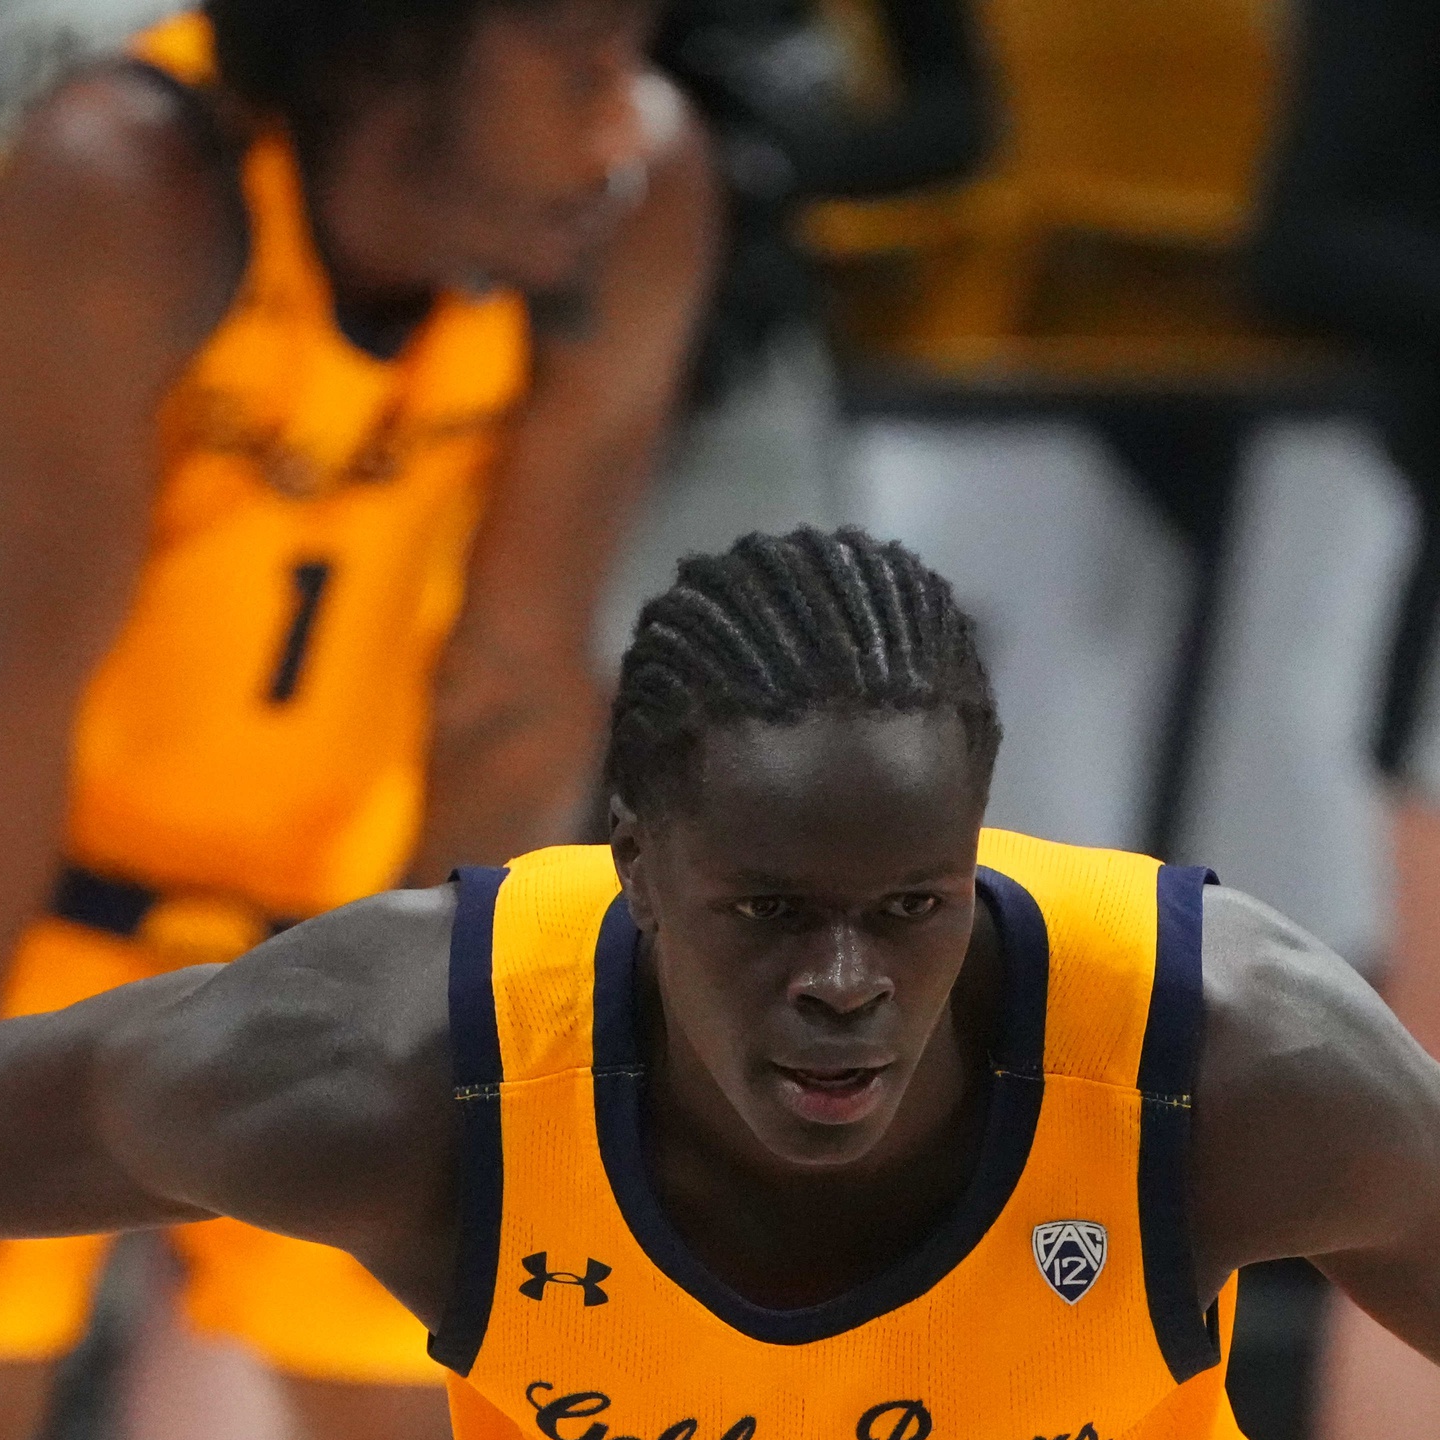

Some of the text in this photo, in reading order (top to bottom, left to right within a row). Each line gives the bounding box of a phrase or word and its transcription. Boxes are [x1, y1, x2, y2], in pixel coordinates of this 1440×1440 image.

[267, 562, 332, 706] 1
[1036, 1223, 1104, 1272] PAC
[1053, 1255, 1089, 1287] 12
